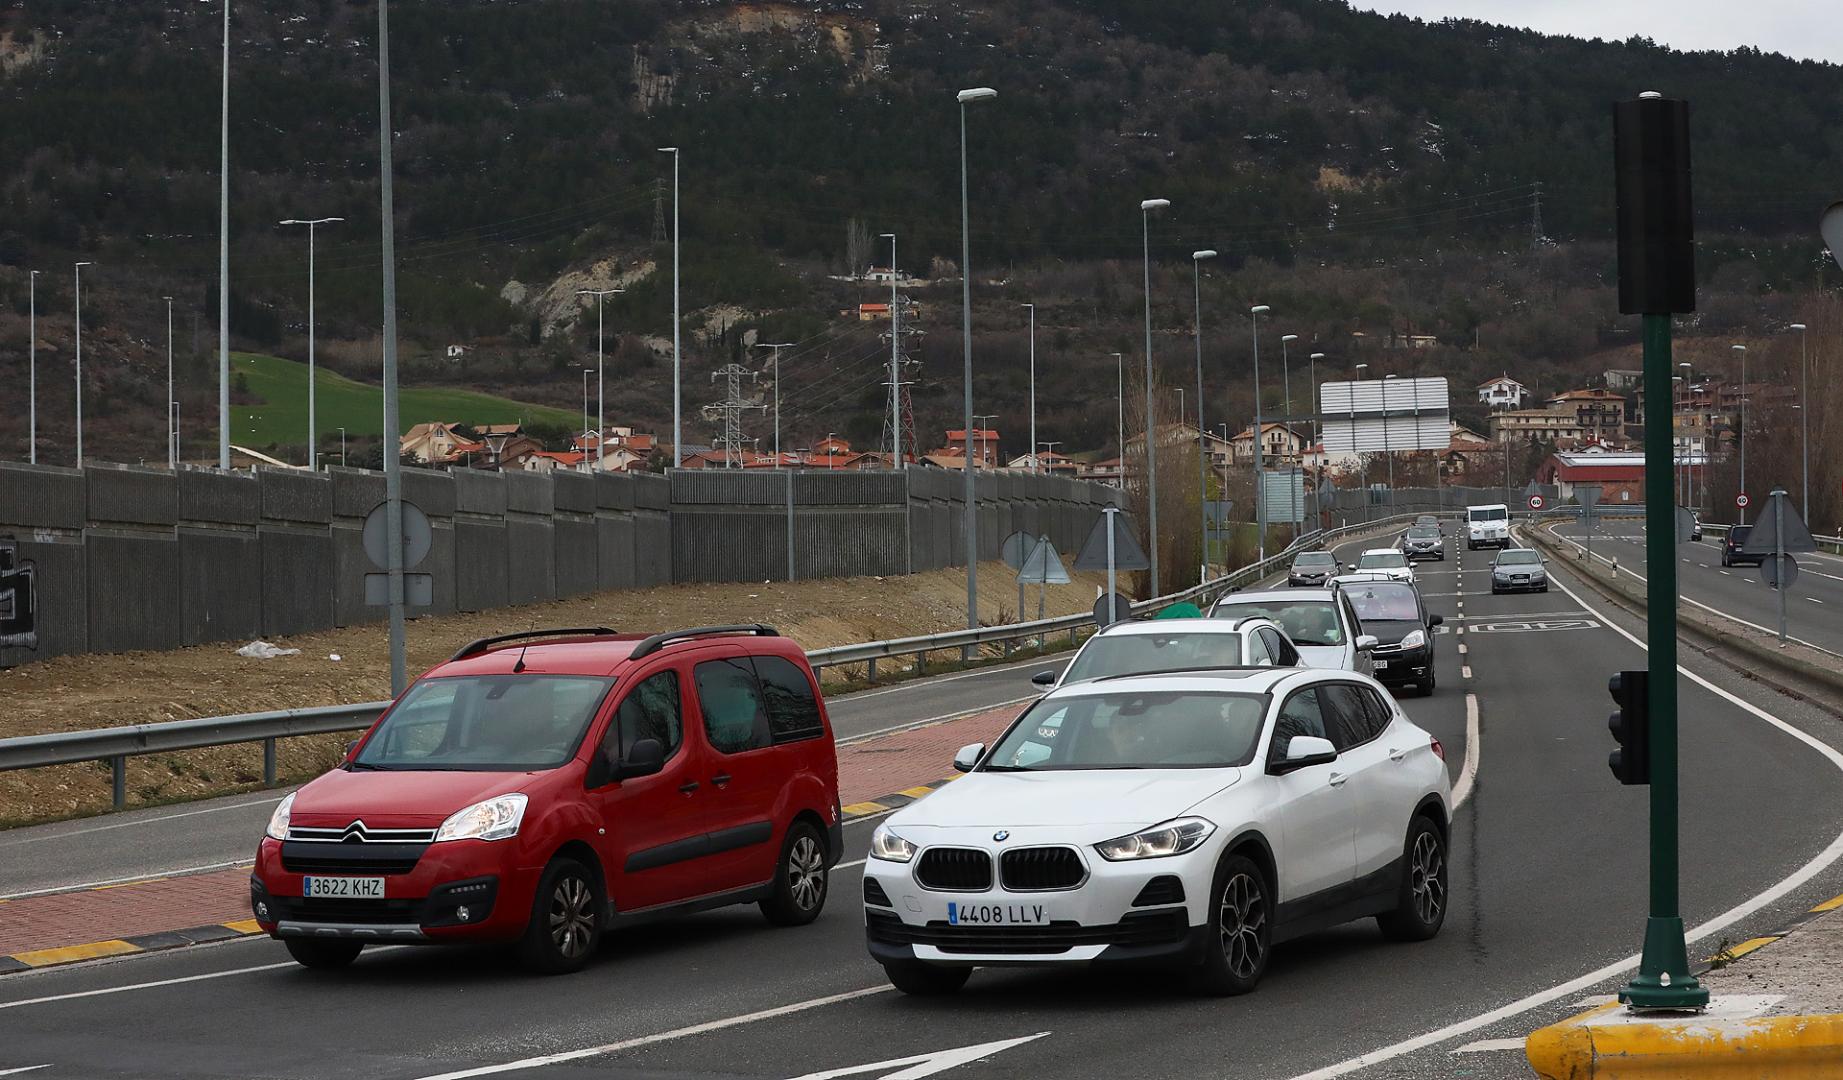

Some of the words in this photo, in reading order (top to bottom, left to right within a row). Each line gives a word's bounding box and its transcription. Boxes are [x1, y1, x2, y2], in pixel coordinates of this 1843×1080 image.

[314, 879, 348, 895] 3622
[353, 879, 380, 896] KHZ
[960, 905, 1002, 923] 4408
[1008, 905, 1042, 923] LLV
